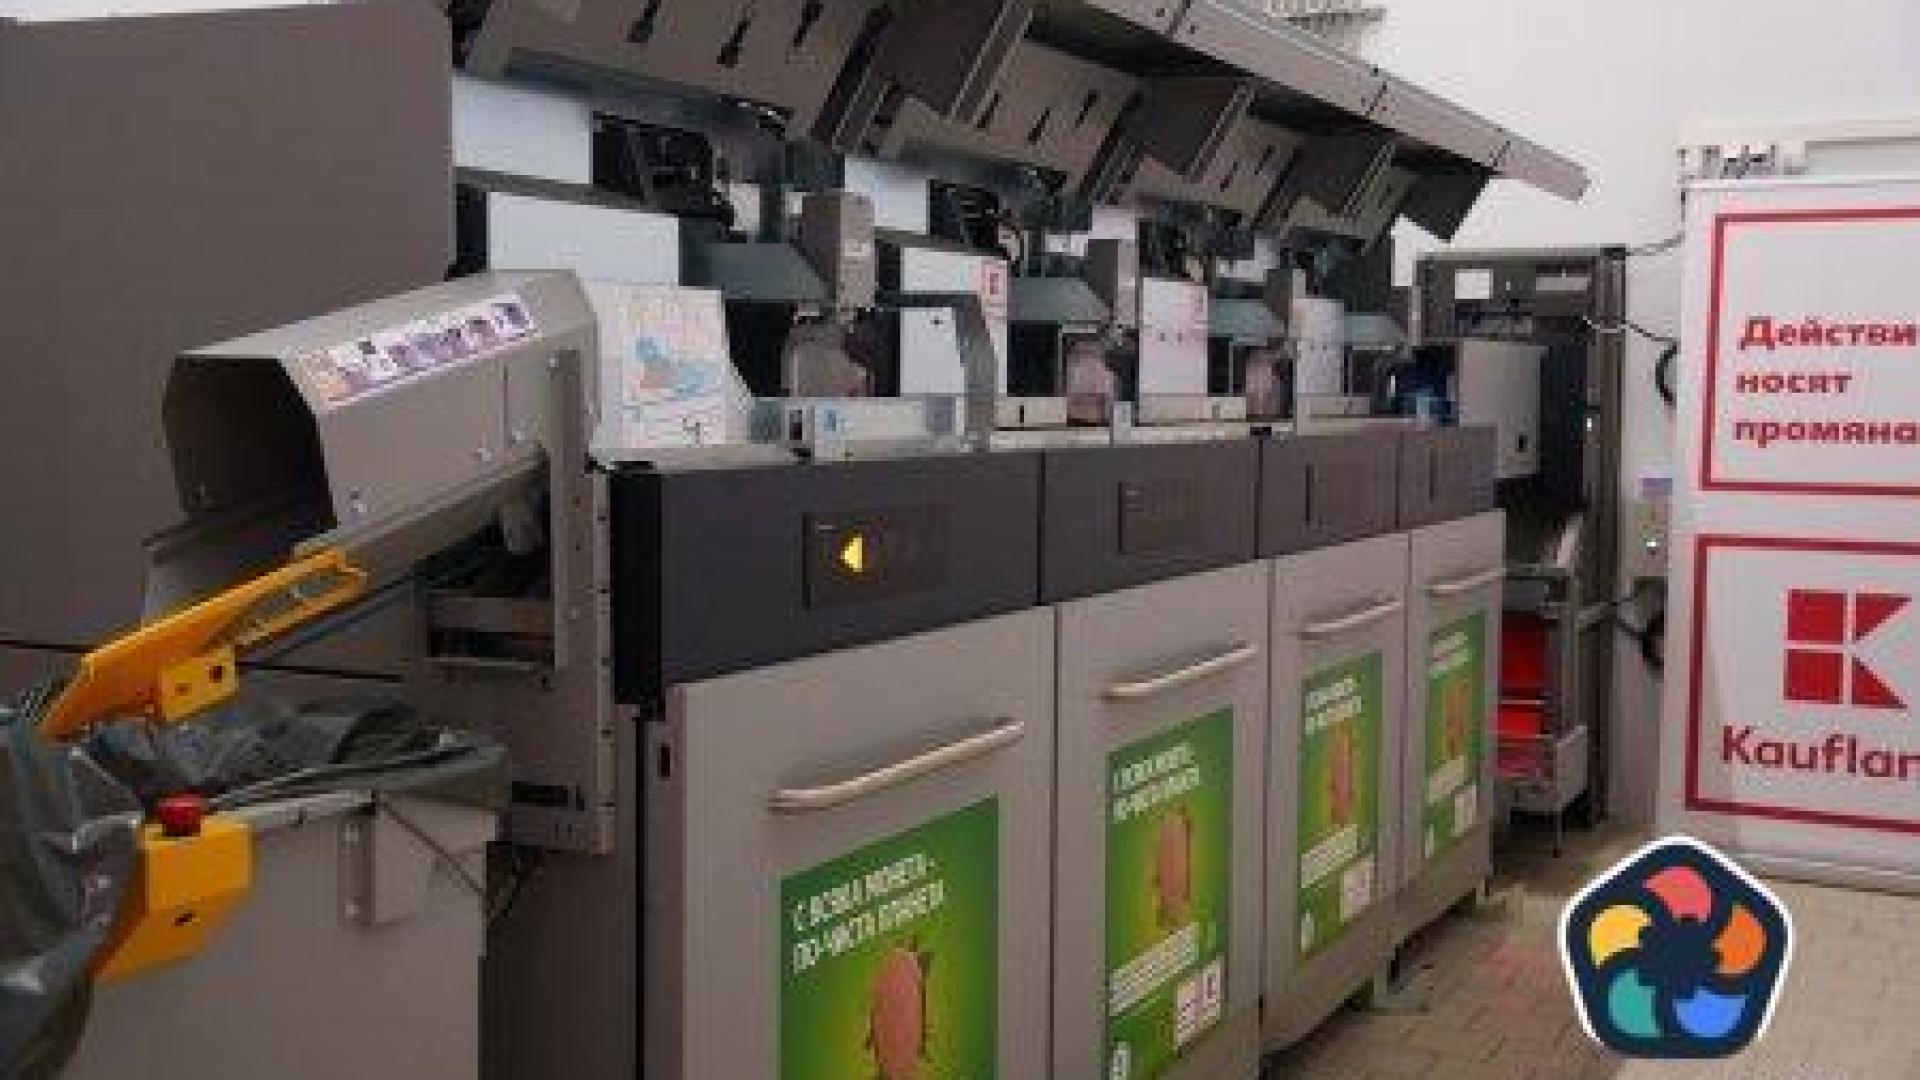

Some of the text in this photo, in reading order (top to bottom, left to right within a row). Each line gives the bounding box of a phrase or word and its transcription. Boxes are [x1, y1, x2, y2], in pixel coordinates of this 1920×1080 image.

[1737, 315, 1917, 350] Действи
[1736, 372, 1852, 394] носят
[1735, 421, 1918, 448] промяна
